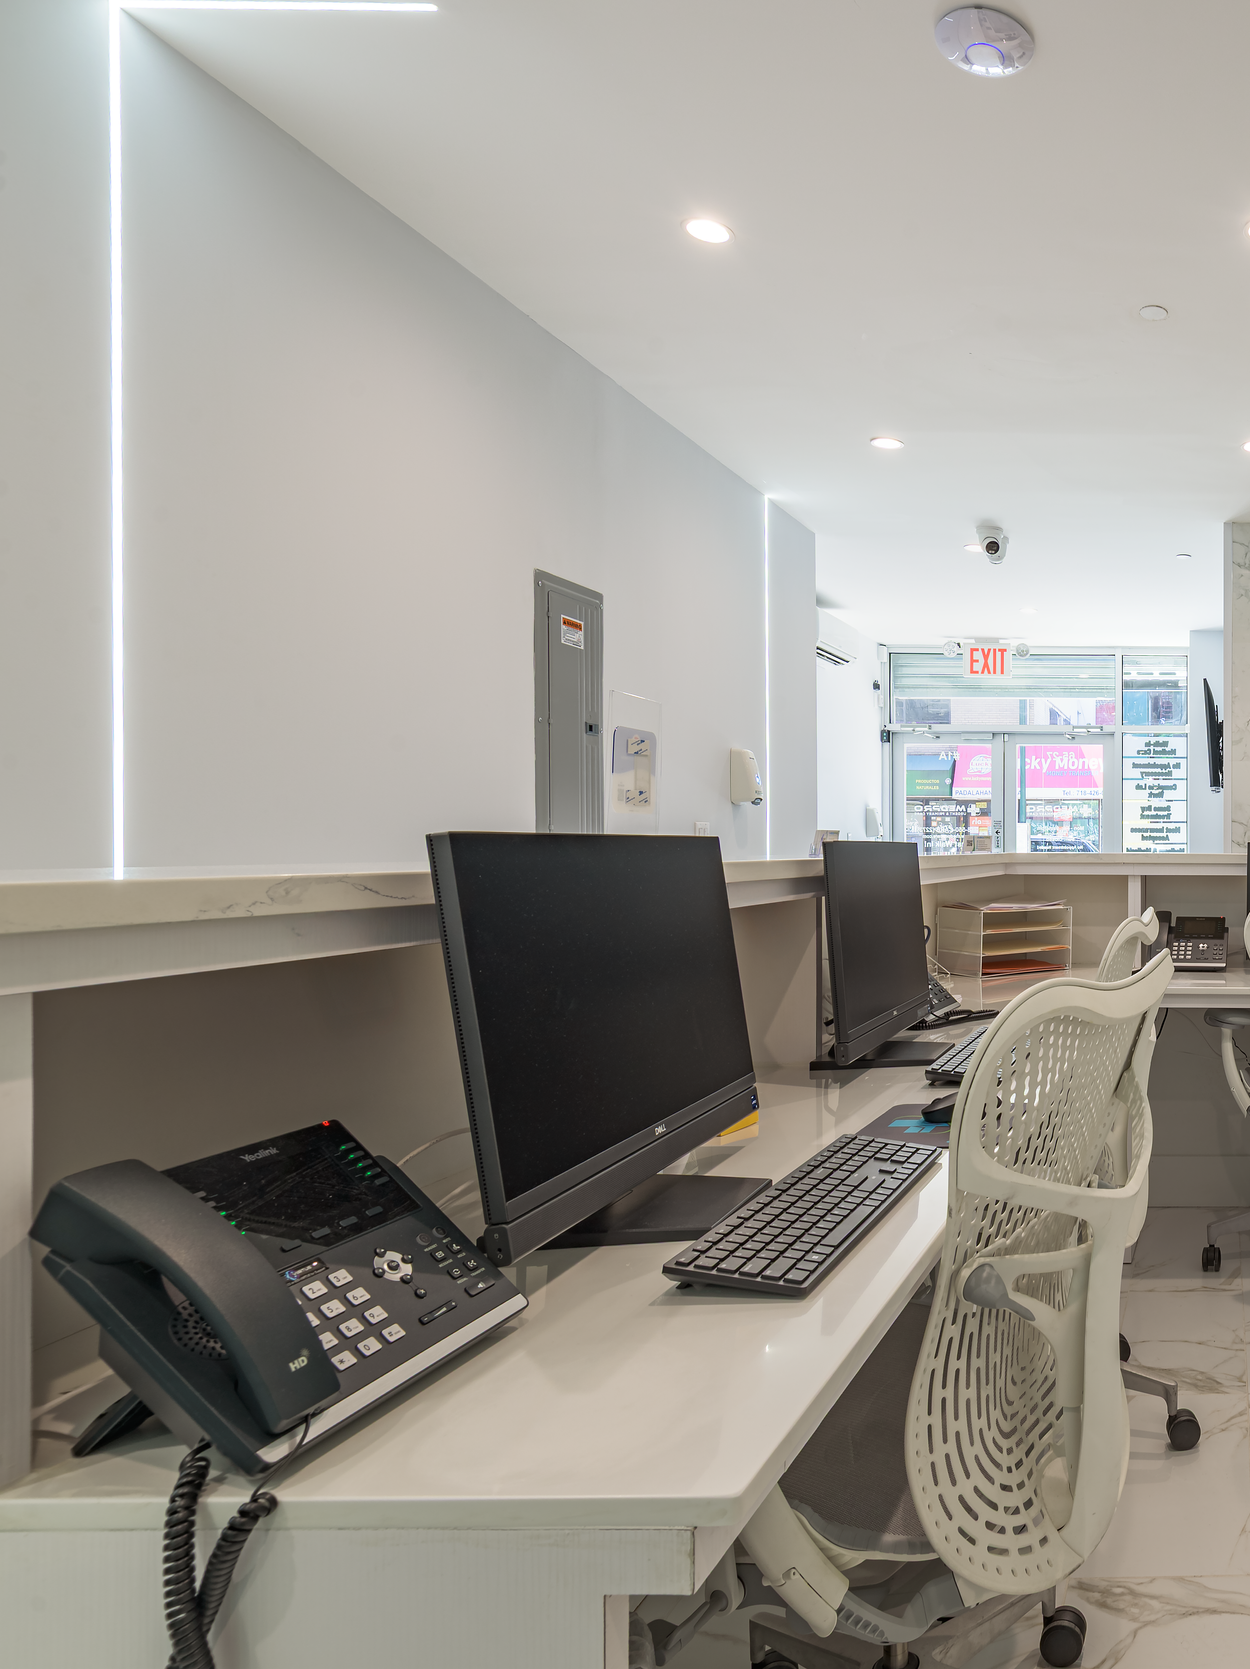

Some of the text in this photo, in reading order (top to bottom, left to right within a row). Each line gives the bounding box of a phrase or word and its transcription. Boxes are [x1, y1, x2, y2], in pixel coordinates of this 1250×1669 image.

[970, 647, 1007, 675] EXIT
[654, 1123, 667, 1136] DELL
[239, 1146, 280, 1163] Yealink
[333, 1275, 341, 1283] 3
[308, 1287, 316, 1295] 2
[326, 1306, 334, 1314] 5
[368, 1312, 376, 1320] 9
[344, 1325, 352, 1333] 8
[288, 1356, 308, 1373] HD
